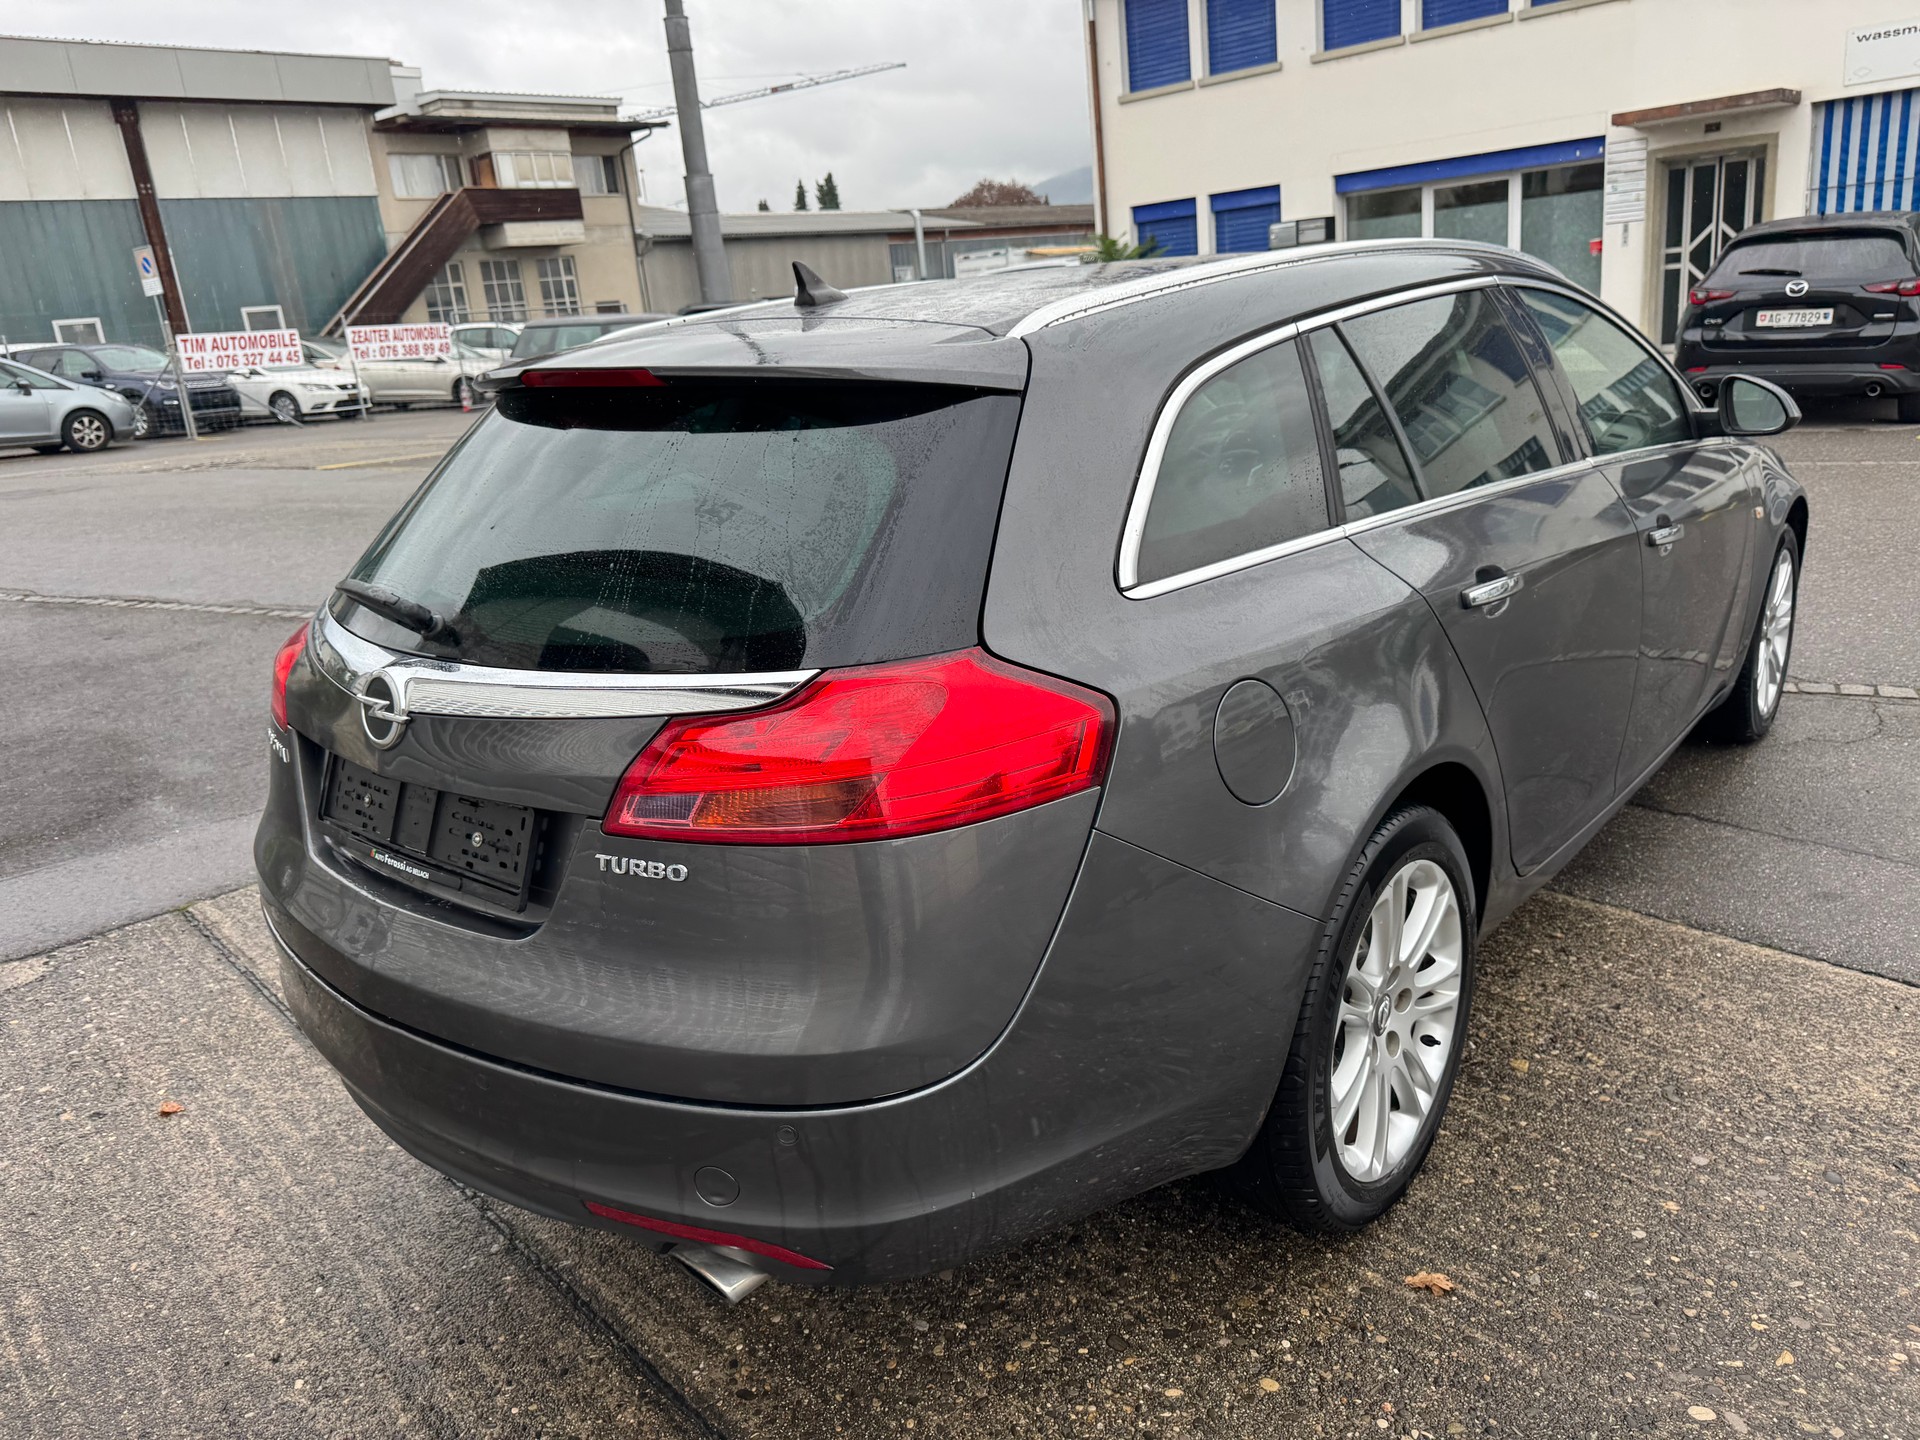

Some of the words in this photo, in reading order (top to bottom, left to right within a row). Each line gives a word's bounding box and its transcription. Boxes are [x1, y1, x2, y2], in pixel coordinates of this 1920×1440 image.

[1856, 26, 1920, 43] wassm
[180, 337, 207, 354] TIM
[211, 333, 298, 352] AUTOMOBILE
[351, 329, 390, 344] ZEAITER
[393, 326, 449, 341] AUTOMOBILE
[216, 354, 239, 369] 076
[243, 352, 264, 367] 327
[268, 351, 283, 364] 44
[286, 350, 300, 364] 45
[379, 345, 399, 358] 076
[595, 853, 688, 881] TURBO
